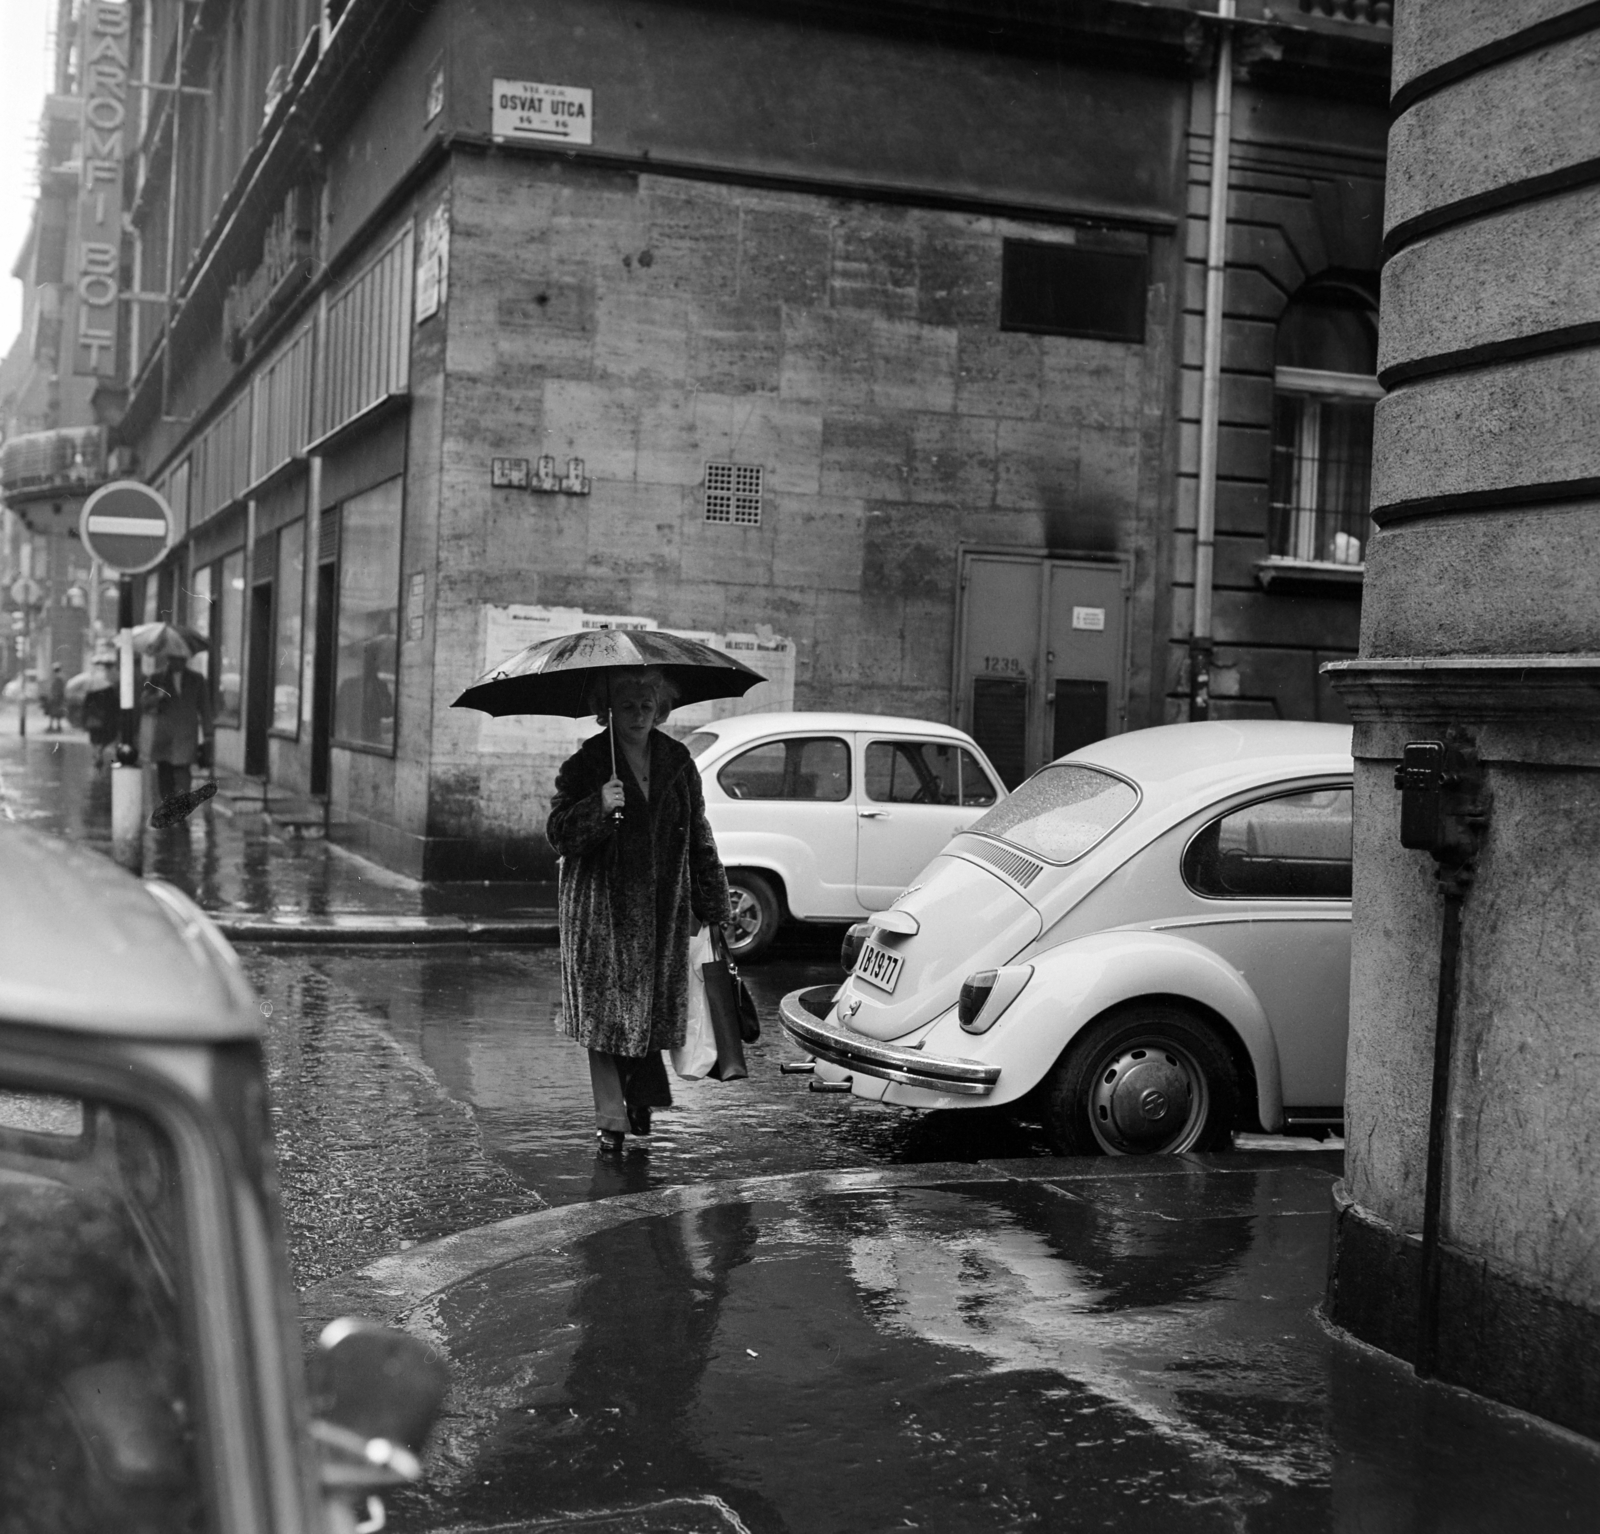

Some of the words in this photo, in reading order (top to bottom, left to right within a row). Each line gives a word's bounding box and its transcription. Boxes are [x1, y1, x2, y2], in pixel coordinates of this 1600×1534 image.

[86, 3, 130, 224] BAROMFI
[551, 99, 586, 118] UTCA
[78, 241, 118, 369] BOLT
[984, 656, 1019, 672] 1239
